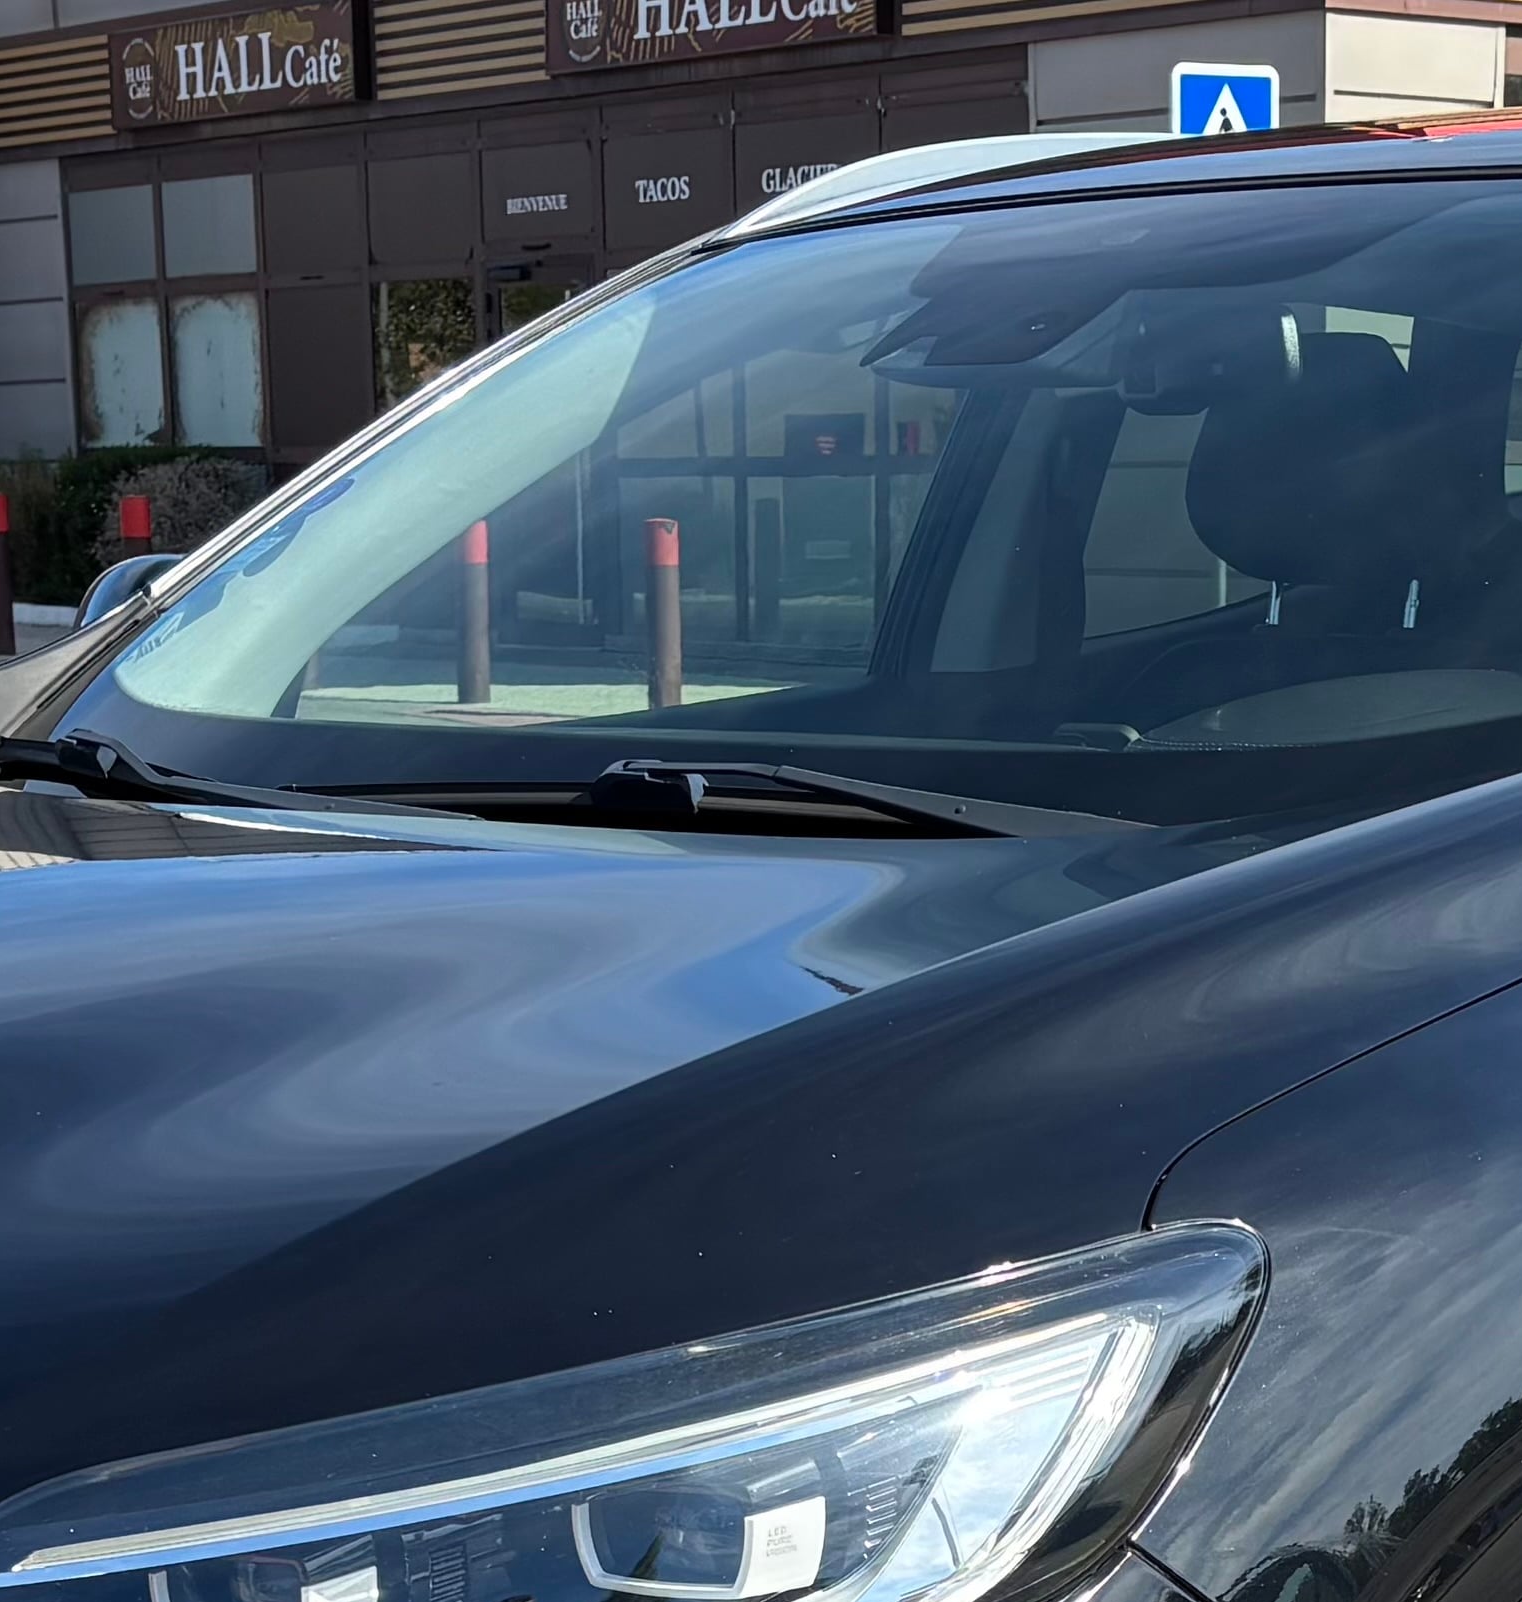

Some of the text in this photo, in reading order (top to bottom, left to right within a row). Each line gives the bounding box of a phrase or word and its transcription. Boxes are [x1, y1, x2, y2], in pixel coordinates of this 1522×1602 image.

[175, 31, 342, 101] HALL Café
[635, 176, 691, 203] TACOS
[506, 194, 568, 214] BIENVENUE
